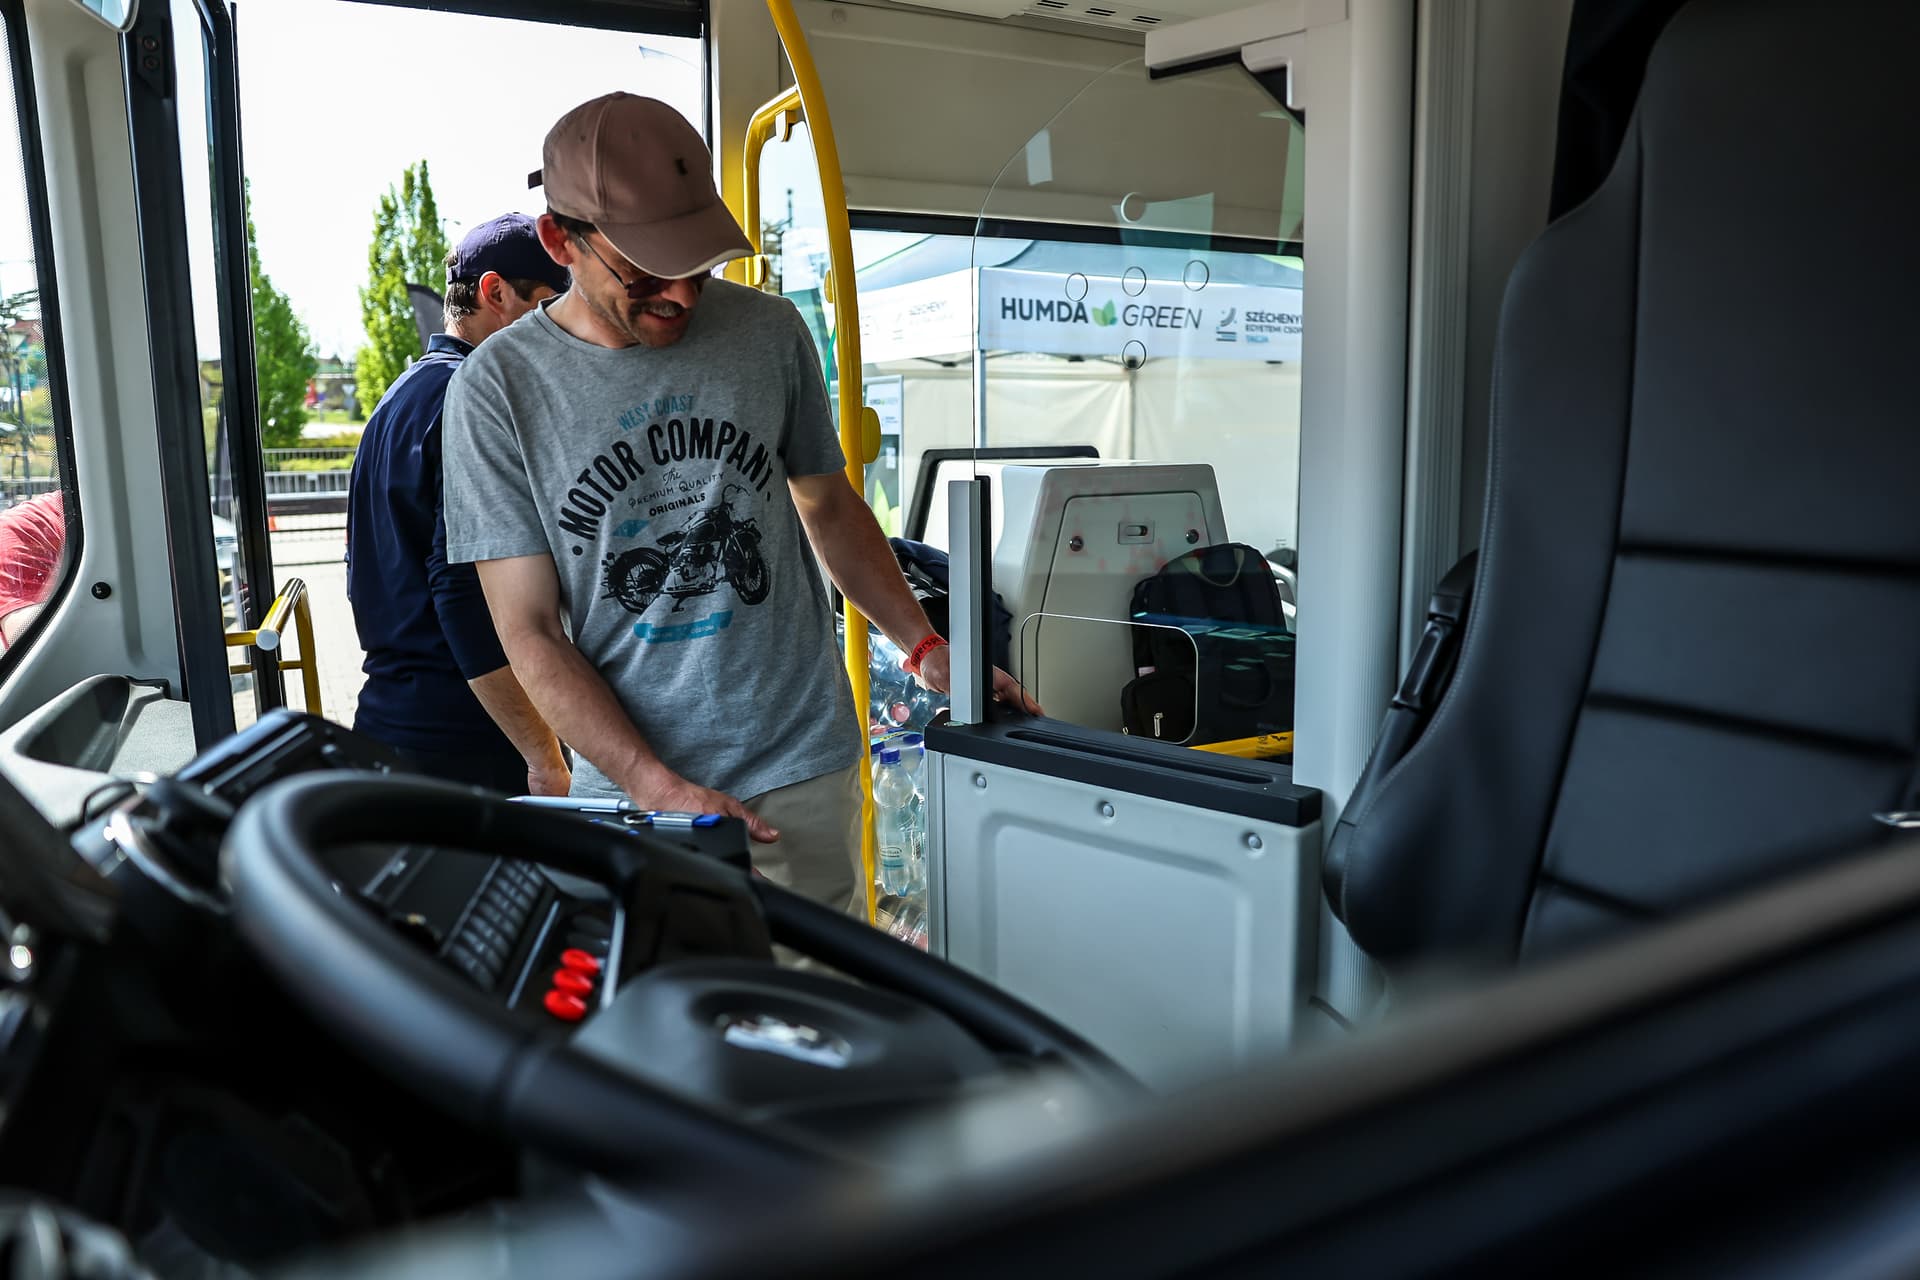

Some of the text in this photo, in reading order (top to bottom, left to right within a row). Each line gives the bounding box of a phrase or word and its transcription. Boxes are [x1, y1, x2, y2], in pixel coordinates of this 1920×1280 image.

[1001, 297, 1202, 329] HUMDA GREEN
[617, 395, 695, 431] WEST COAST
[558, 417, 773, 541] MOTOR COMPANY
[628, 472, 725, 508] PREMIUM QUALITY
[649, 492, 706, 516] ORIGINALS
